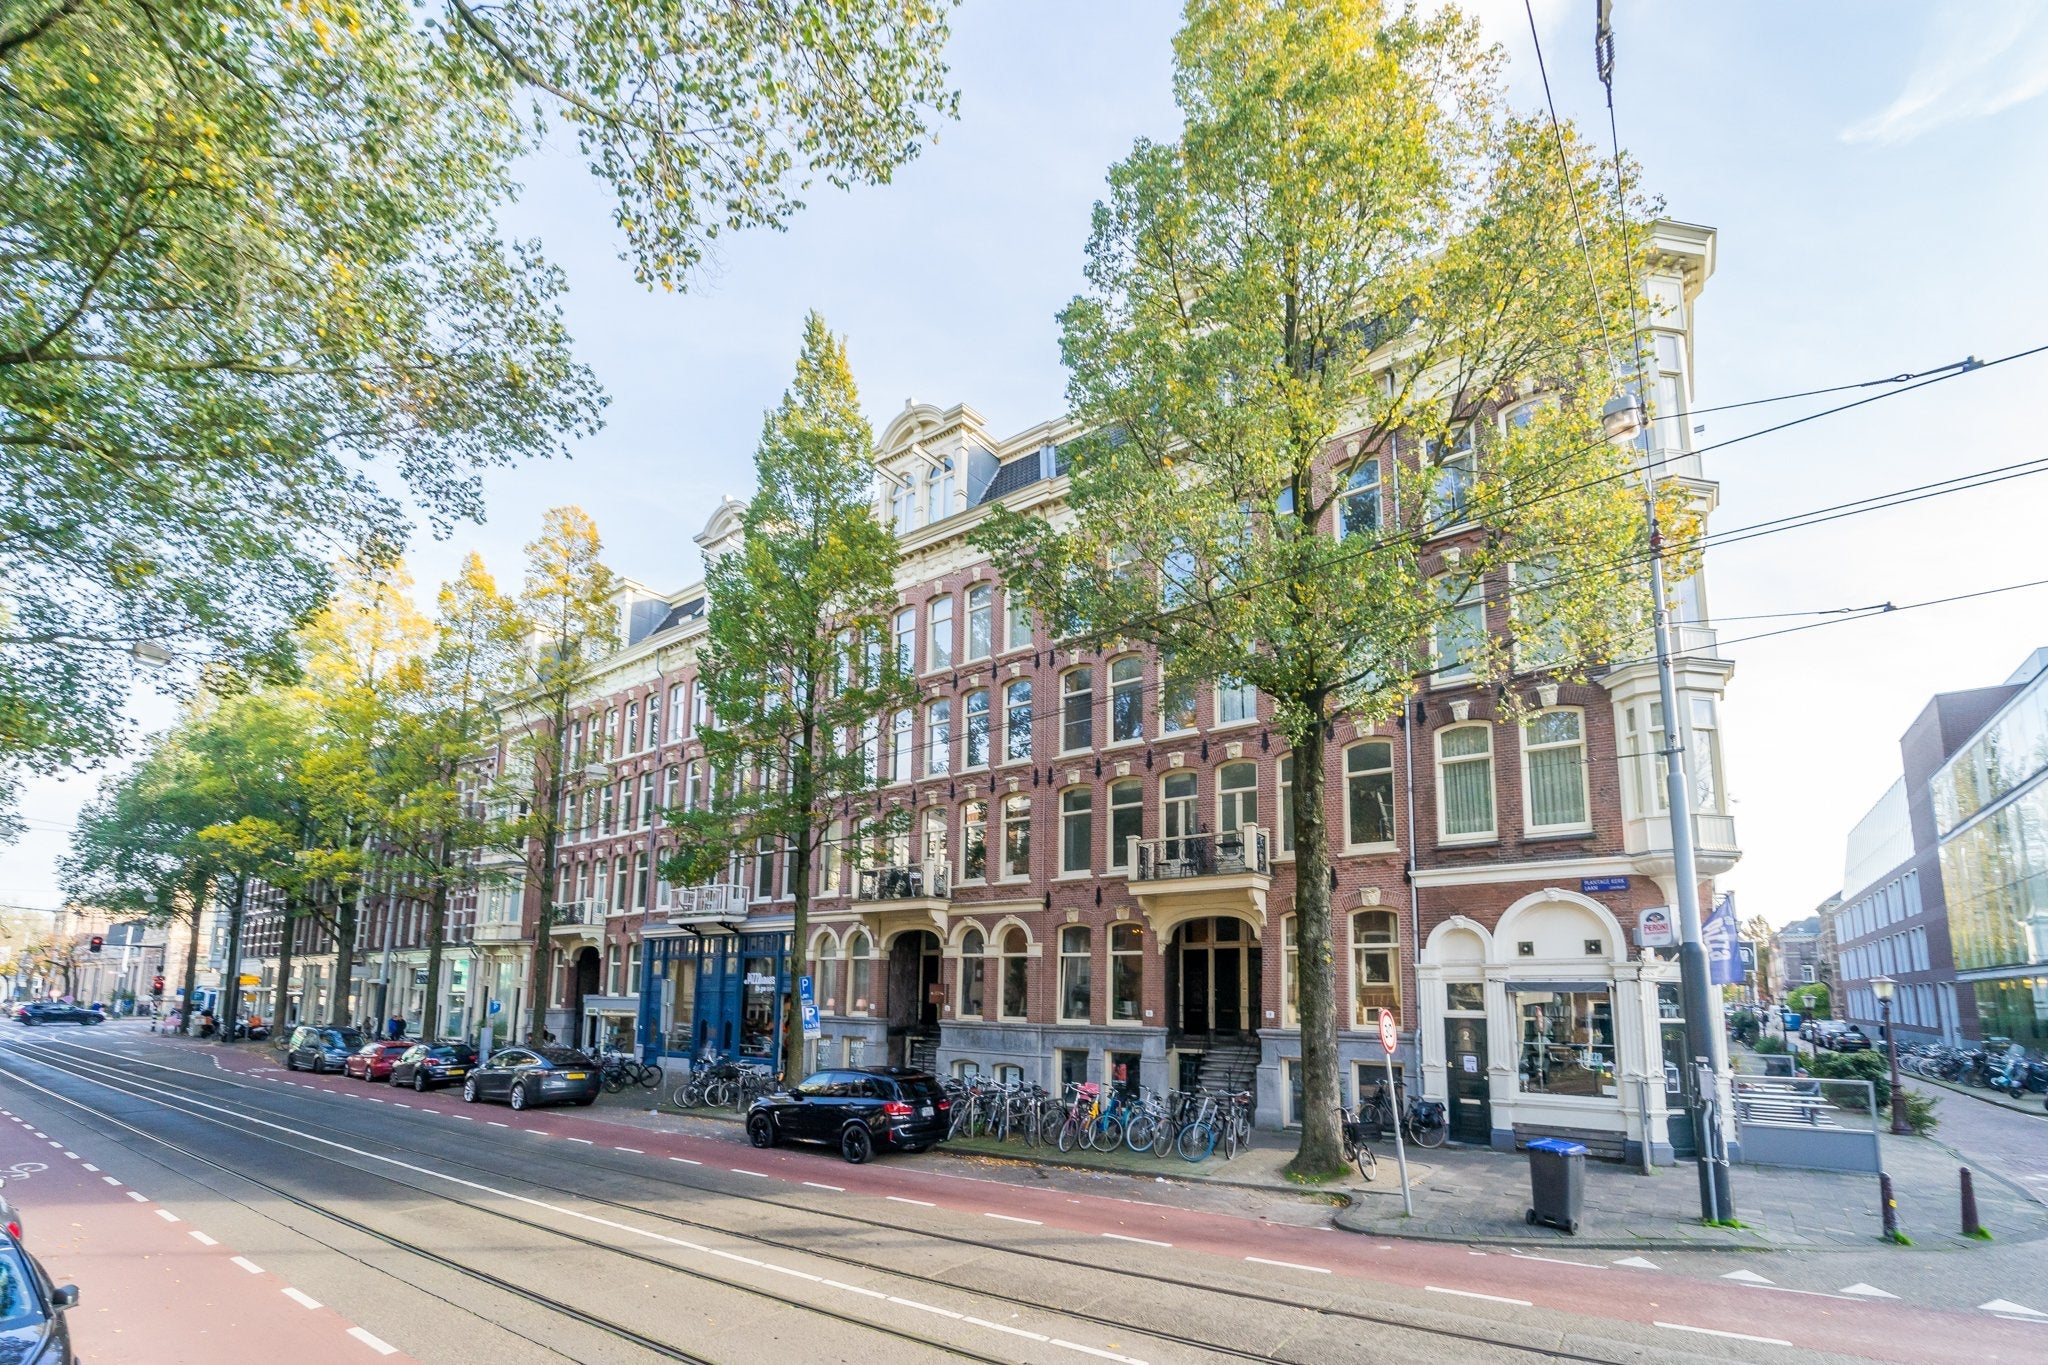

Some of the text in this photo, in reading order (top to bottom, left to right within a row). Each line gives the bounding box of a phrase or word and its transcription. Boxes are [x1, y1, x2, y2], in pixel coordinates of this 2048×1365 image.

[1643, 922, 1669, 931] PERONI
[801, 978, 809, 991] P
[805, 1007, 816, 1021] P
[1463, 1030, 1470, 1041] 2
